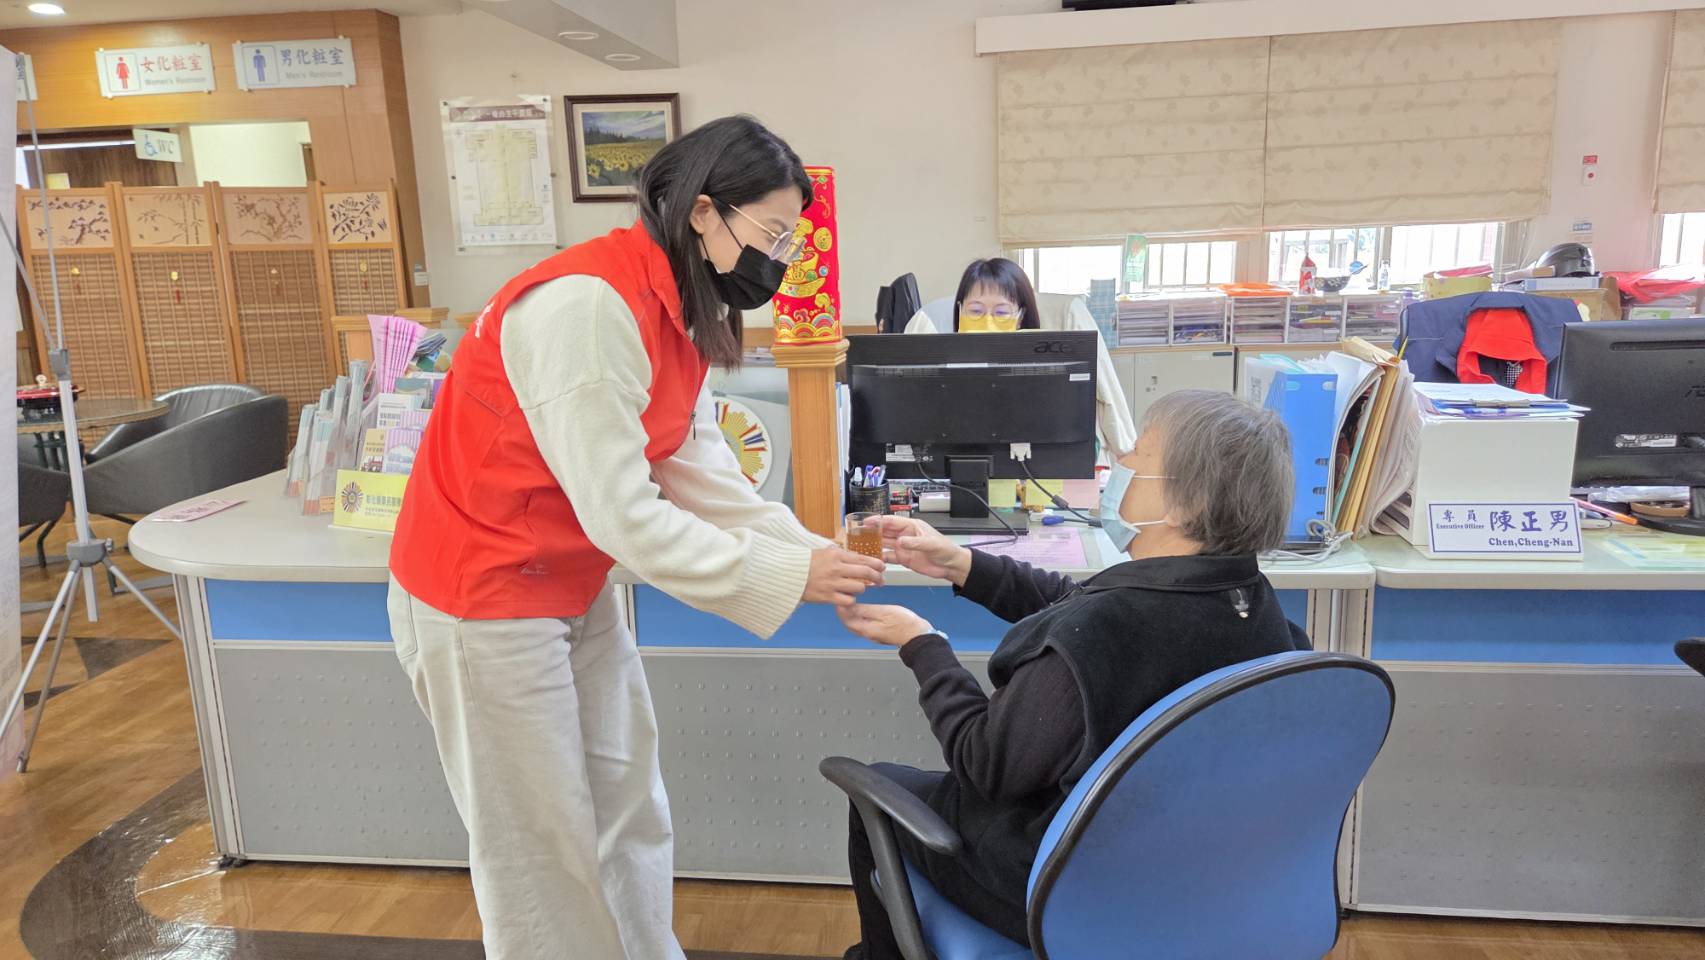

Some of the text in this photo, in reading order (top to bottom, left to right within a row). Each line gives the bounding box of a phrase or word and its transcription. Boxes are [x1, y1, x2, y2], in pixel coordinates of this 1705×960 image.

[140, 52, 203, 73] 女化粧室
[280, 46, 345, 67] 男化粧室
[1033, 340, 1078, 354] ace
[1489, 510, 1569, 533] 陳正男
